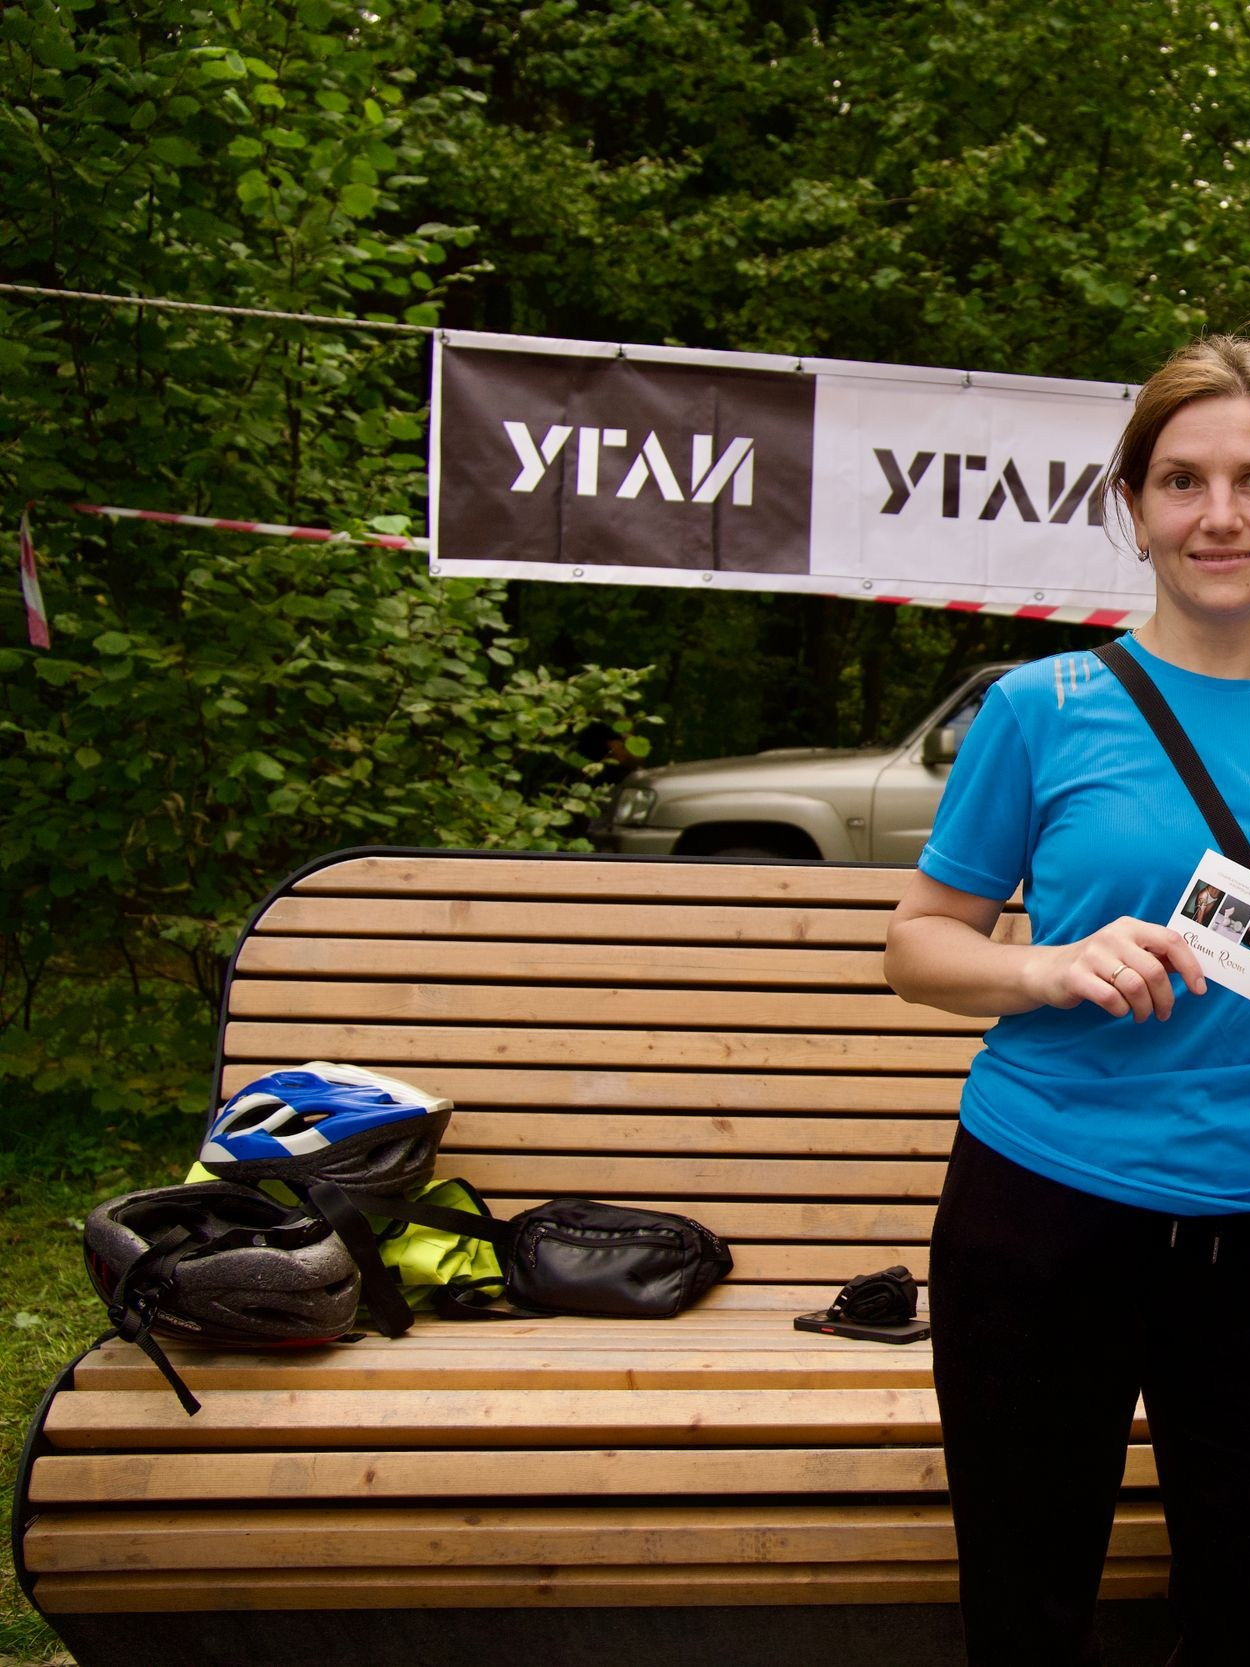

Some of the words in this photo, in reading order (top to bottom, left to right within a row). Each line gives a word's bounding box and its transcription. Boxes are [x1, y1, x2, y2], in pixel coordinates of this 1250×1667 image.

[503, 421, 754, 506] УГЛИ
[873, 448, 1104, 527] УГЛИ
[1218, 950, 1247, 975] Room
